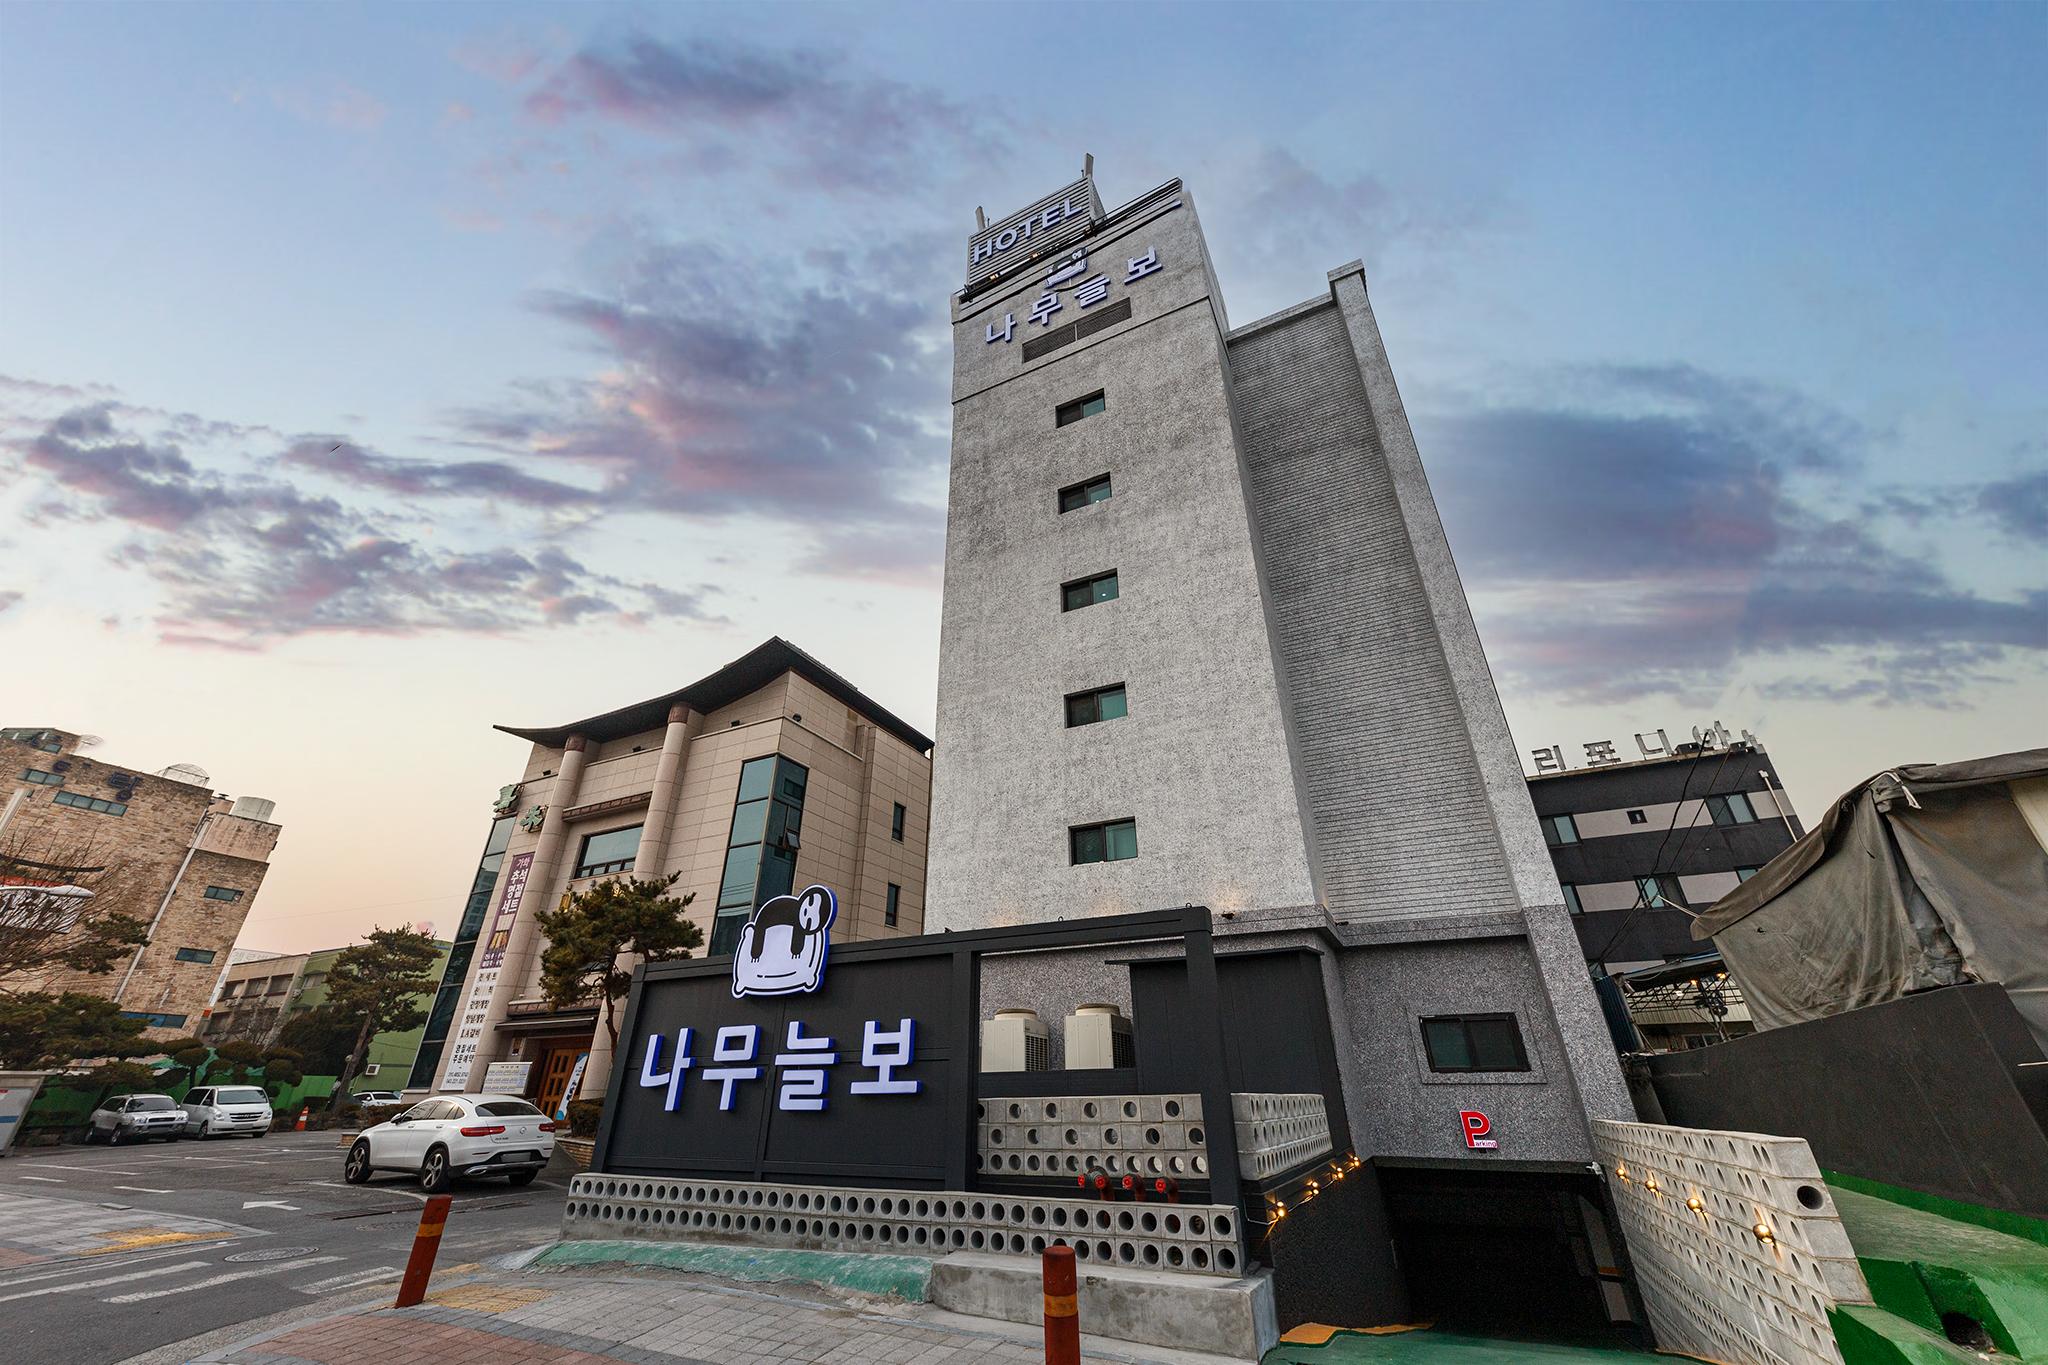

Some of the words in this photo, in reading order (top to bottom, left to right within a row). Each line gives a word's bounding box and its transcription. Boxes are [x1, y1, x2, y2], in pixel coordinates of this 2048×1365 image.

[973, 198, 1084, 266] HOTEL
[985, 245, 1164, 343] 나무늘보
[506, 883, 524, 899] 명절
[511, 868, 529, 885] 추석
[501, 899, 520, 914] 세트
[639, 1017, 923, 1112] 나무늘보
